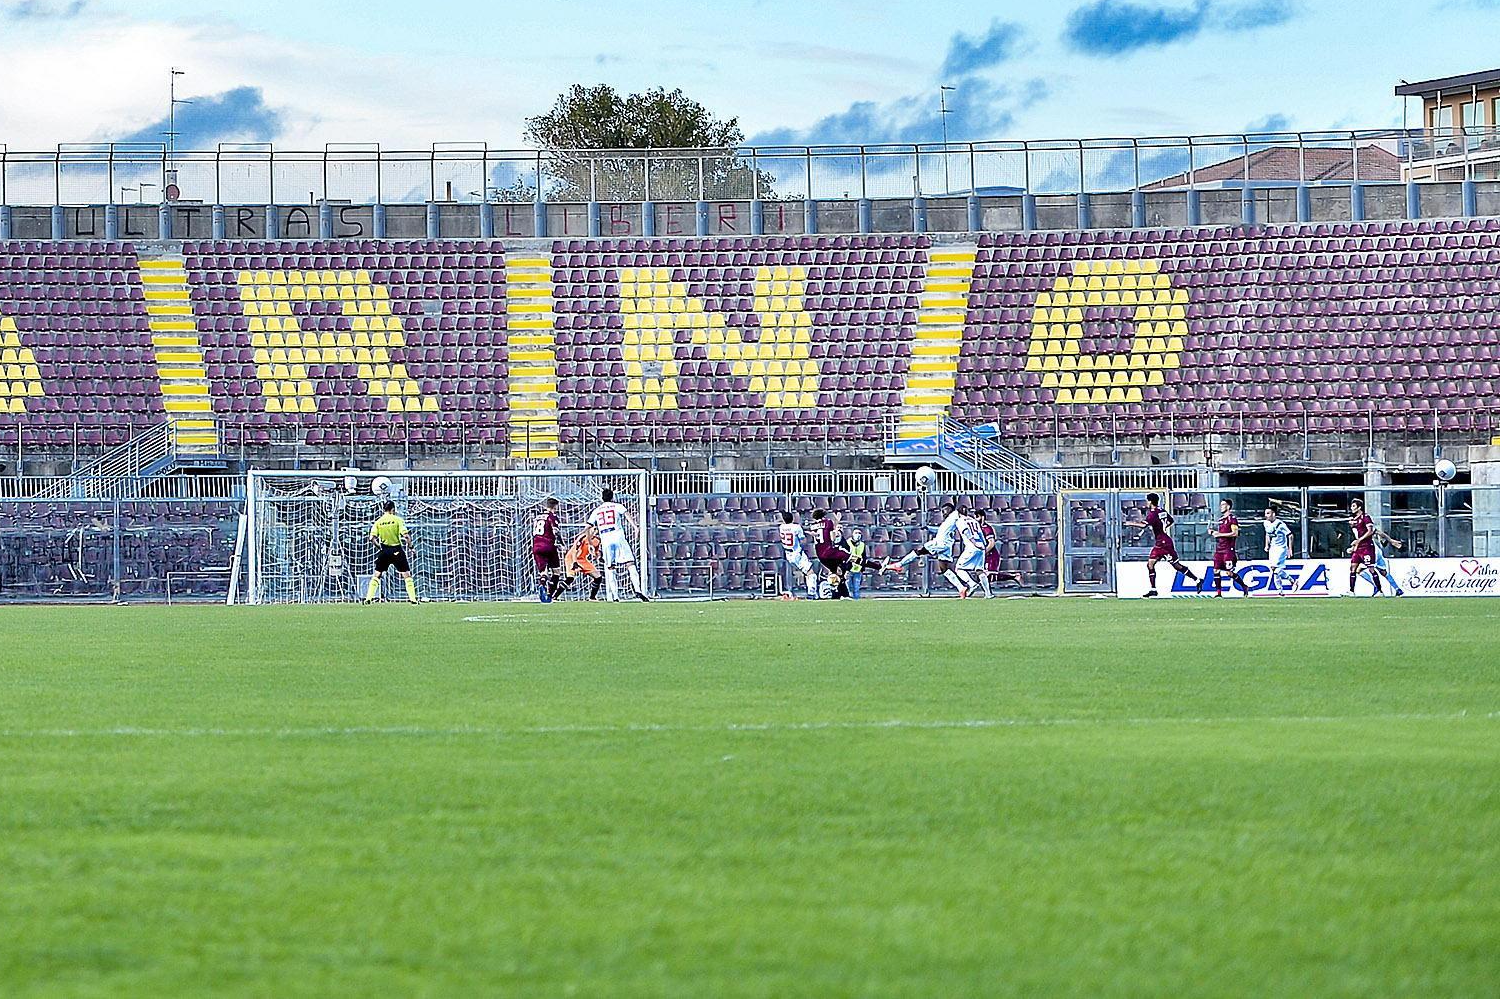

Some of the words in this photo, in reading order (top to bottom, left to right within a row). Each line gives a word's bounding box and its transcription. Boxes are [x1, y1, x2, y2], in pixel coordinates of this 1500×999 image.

[75, 207, 364, 238] ULTRAS
[506, 205, 784, 235] LIBERI
[597, 509, 616, 526] 33
